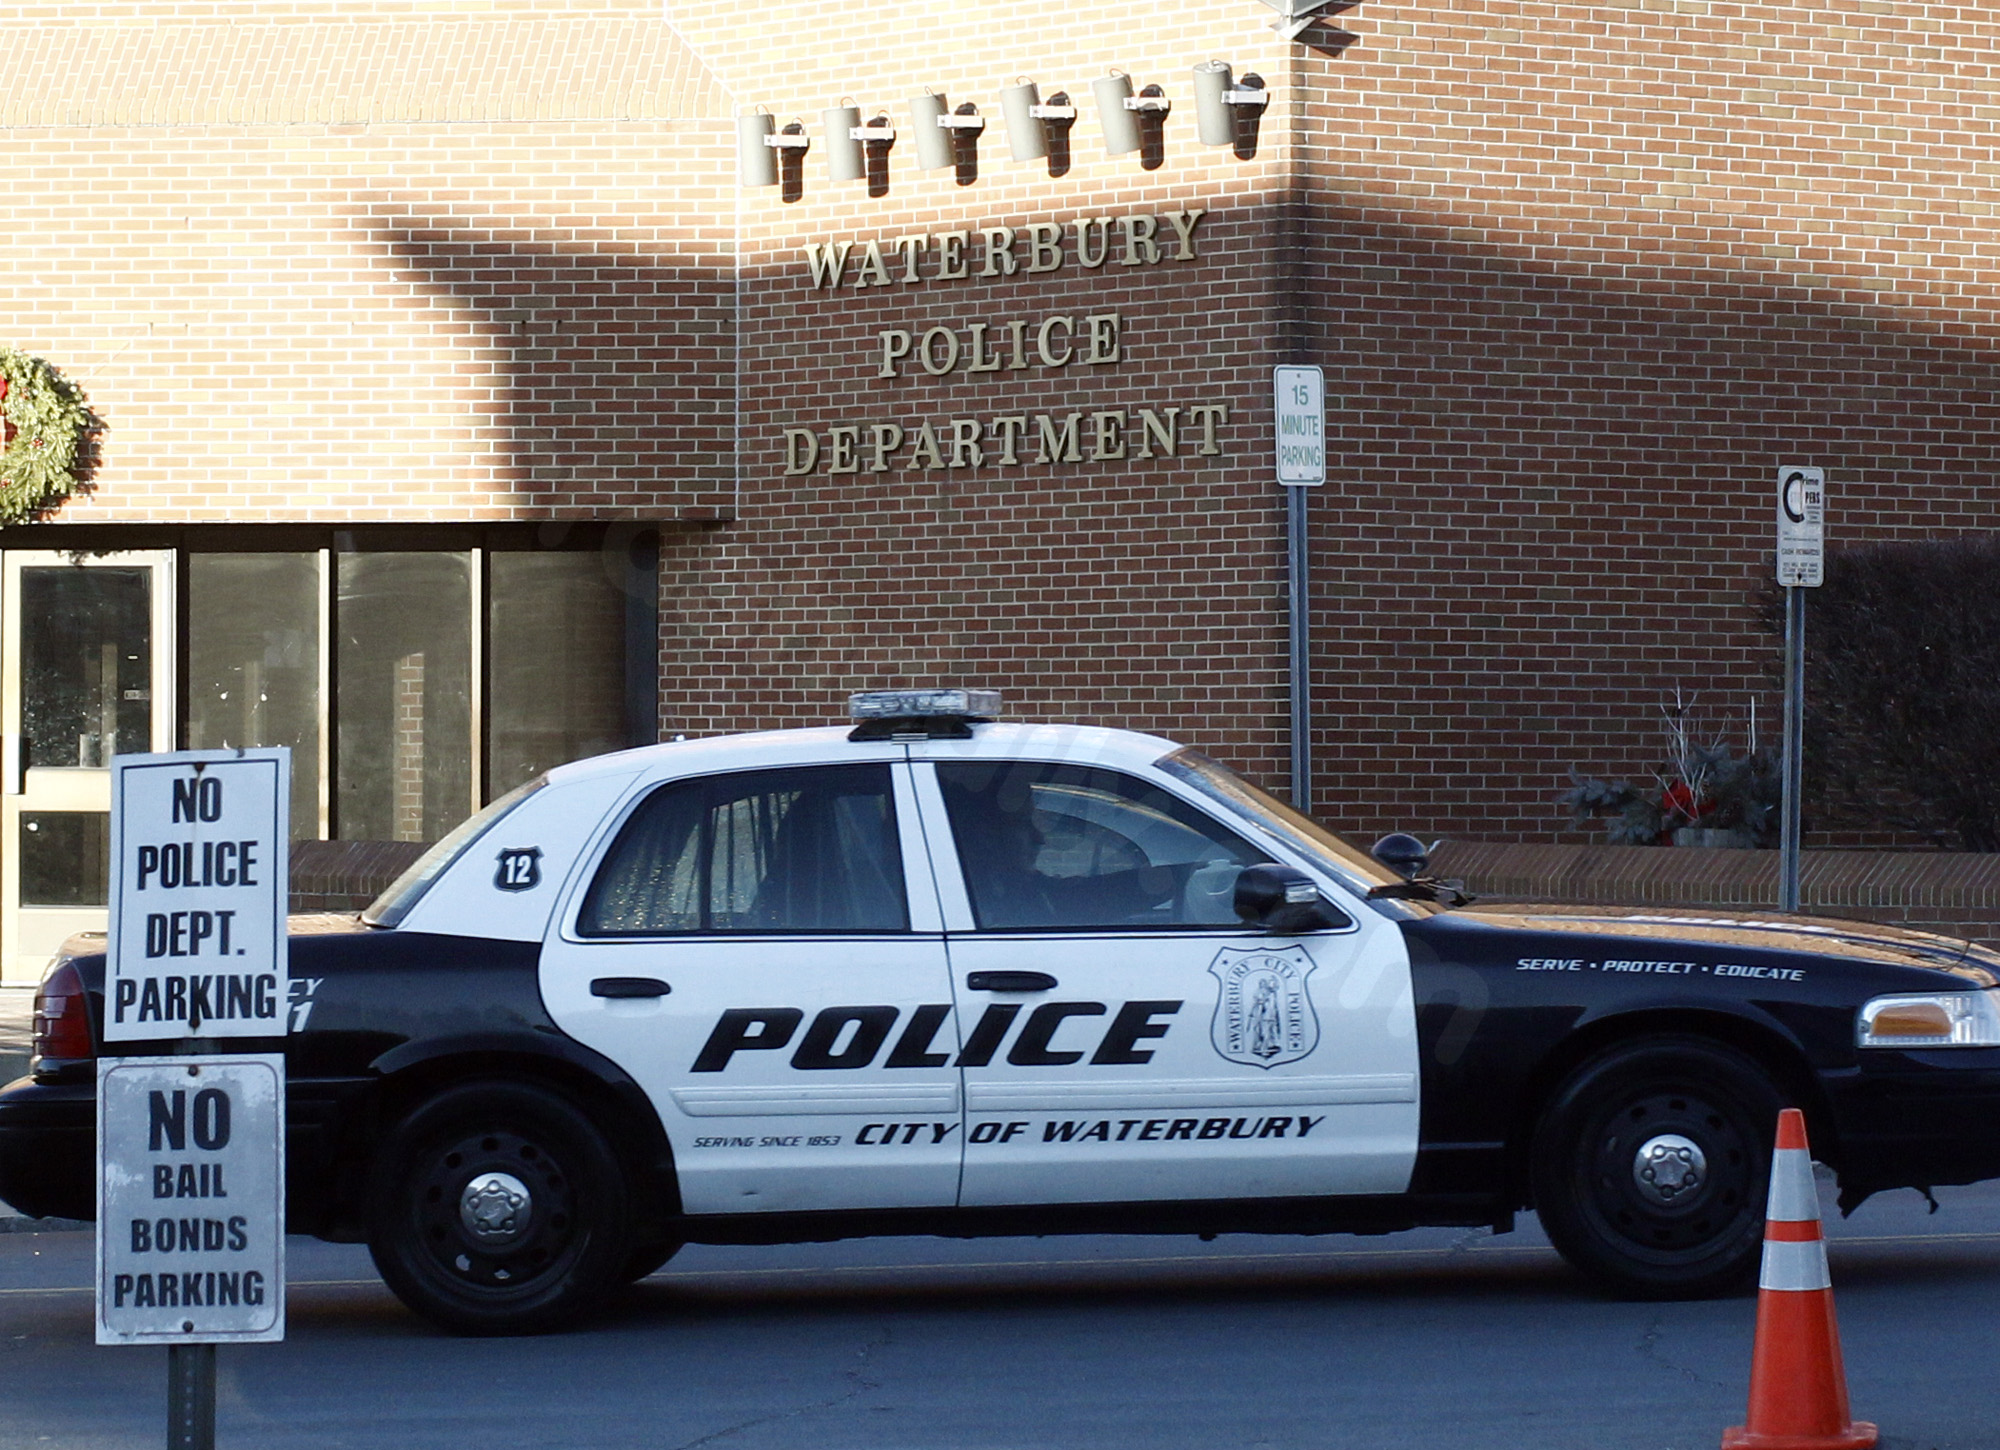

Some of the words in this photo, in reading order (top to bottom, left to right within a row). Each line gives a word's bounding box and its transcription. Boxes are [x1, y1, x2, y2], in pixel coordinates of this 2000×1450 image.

[802, 208, 1208, 290] WATERBURY
[877, 313, 1123, 379] POLICE
[1292, 384, 1309, 406] 15
[783, 404, 1230, 477] DEPARTMENT
[1281, 414, 1319, 436] MINUTE
[1281, 445, 1321, 467] PARKING
[171, 777, 222, 824] NO
[136, 840, 258, 891] POLICE
[505, 854, 532, 884] 12
[146, 910, 246, 959] DEPT.
[1516, 958, 1584, 972] SERVE
[1601, 959, 1697, 975] PROTECT
[1713, 963, 1807, 982] EDUCATE
[115, 973, 277, 1024] PARKING
[1228, 960, 1251, 1043] WATERBURY
[1264, 957, 1297, 980] CITY
[1288, 992, 1302, 1042] POLICE
[689, 999, 1185, 1074] POLICE
[148, 1088, 232, 1152] NO
[693, 1135, 756, 1149] SERVING
[758, 1135, 802, 1148] SINCE
[806, 1135, 842, 1148] 1853
[855, 1122, 960, 1146] CITY
[968, 1120, 1026, 1144] OF
[1042, 1115, 1328, 1143] WATERBURY
[152, 1163, 228, 1200] BAIL
[130, 1215, 248, 1253] BONDS
[114, 1270, 265, 1308] PARKING
